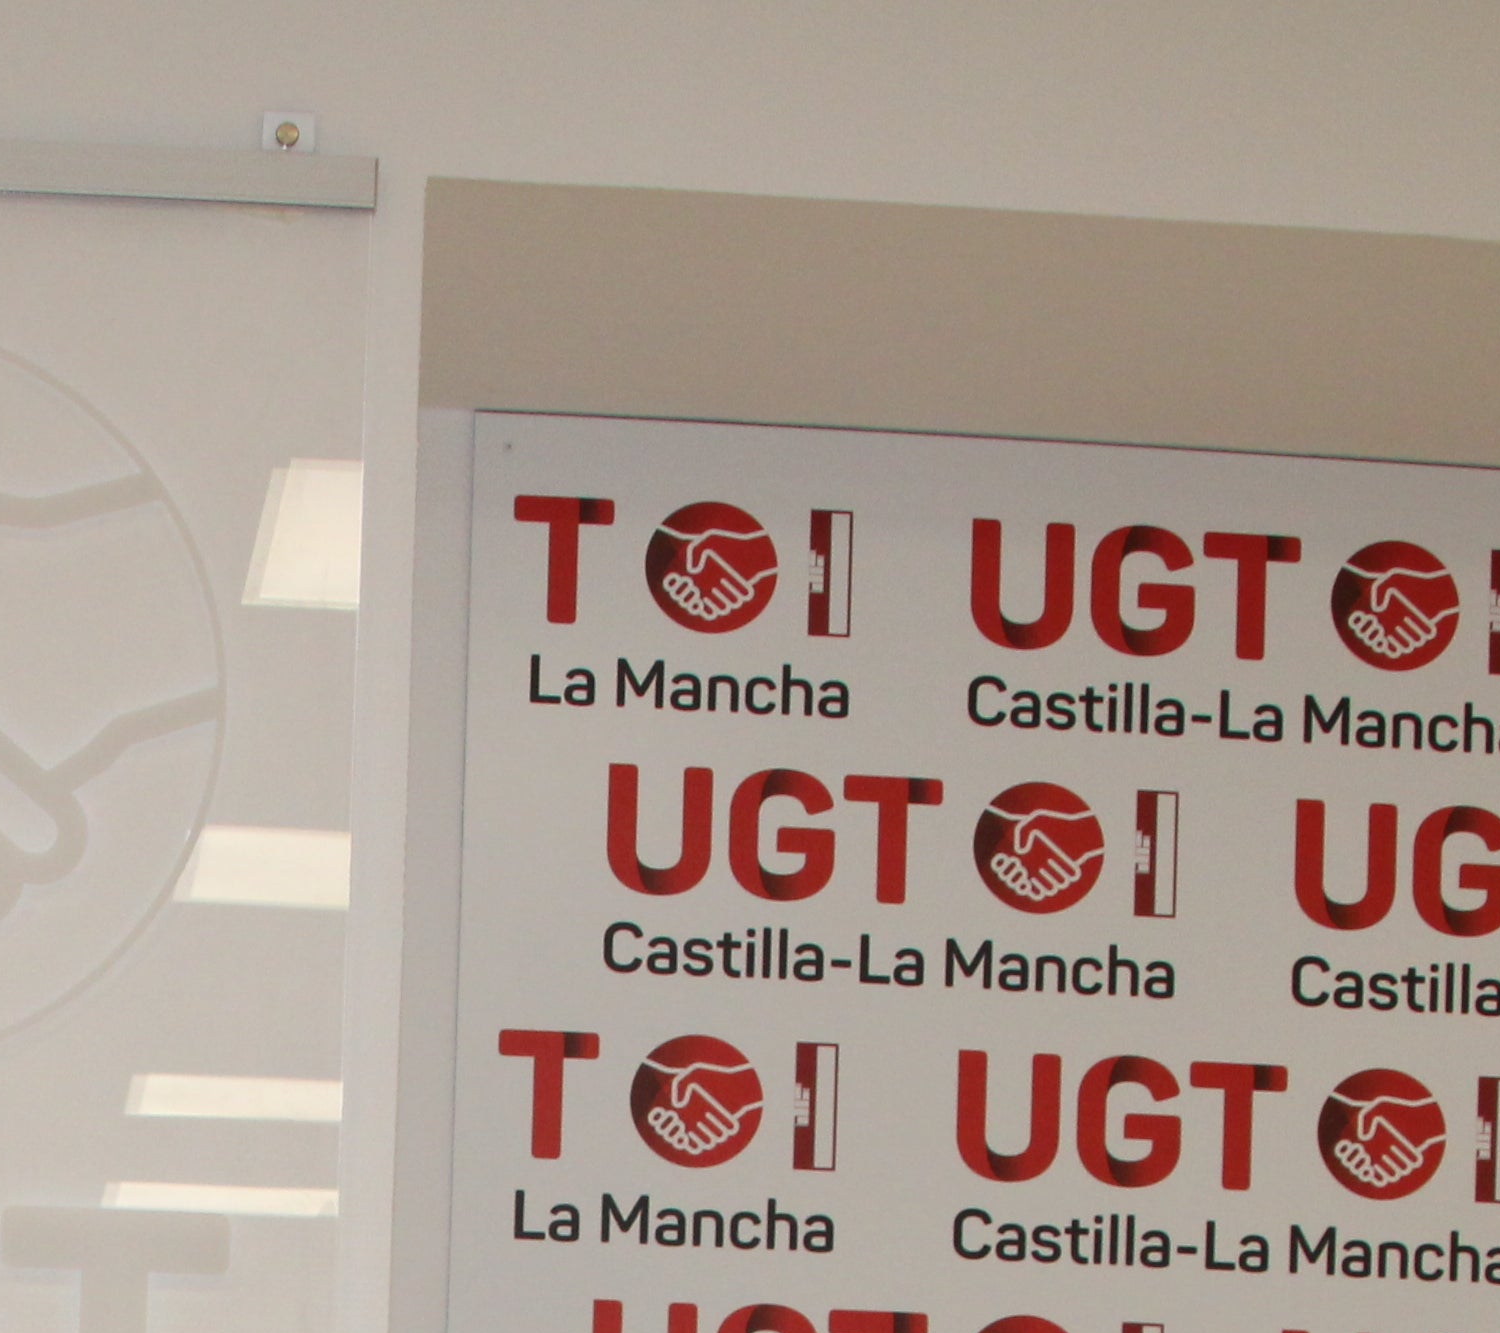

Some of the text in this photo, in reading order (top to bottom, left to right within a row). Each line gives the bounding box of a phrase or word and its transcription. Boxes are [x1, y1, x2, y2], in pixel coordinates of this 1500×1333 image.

[514, 495, 615, 624] T
[971, 518, 1301, 661] UGT
[530, 655, 849, 719] La Mancha
[968, 676, 1283, 742] Castilla-La
[607, 763, 943, 904] UGT
[604, 922, 1174, 999] Castilla-La Mancha
[499, 1029, 599, 1159] T
[956, 1050, 1288, 1191] UGT
[514, 1190, 834, 1253] La Mancha
[953, 1209, 1269, 1273] Castilla-La
